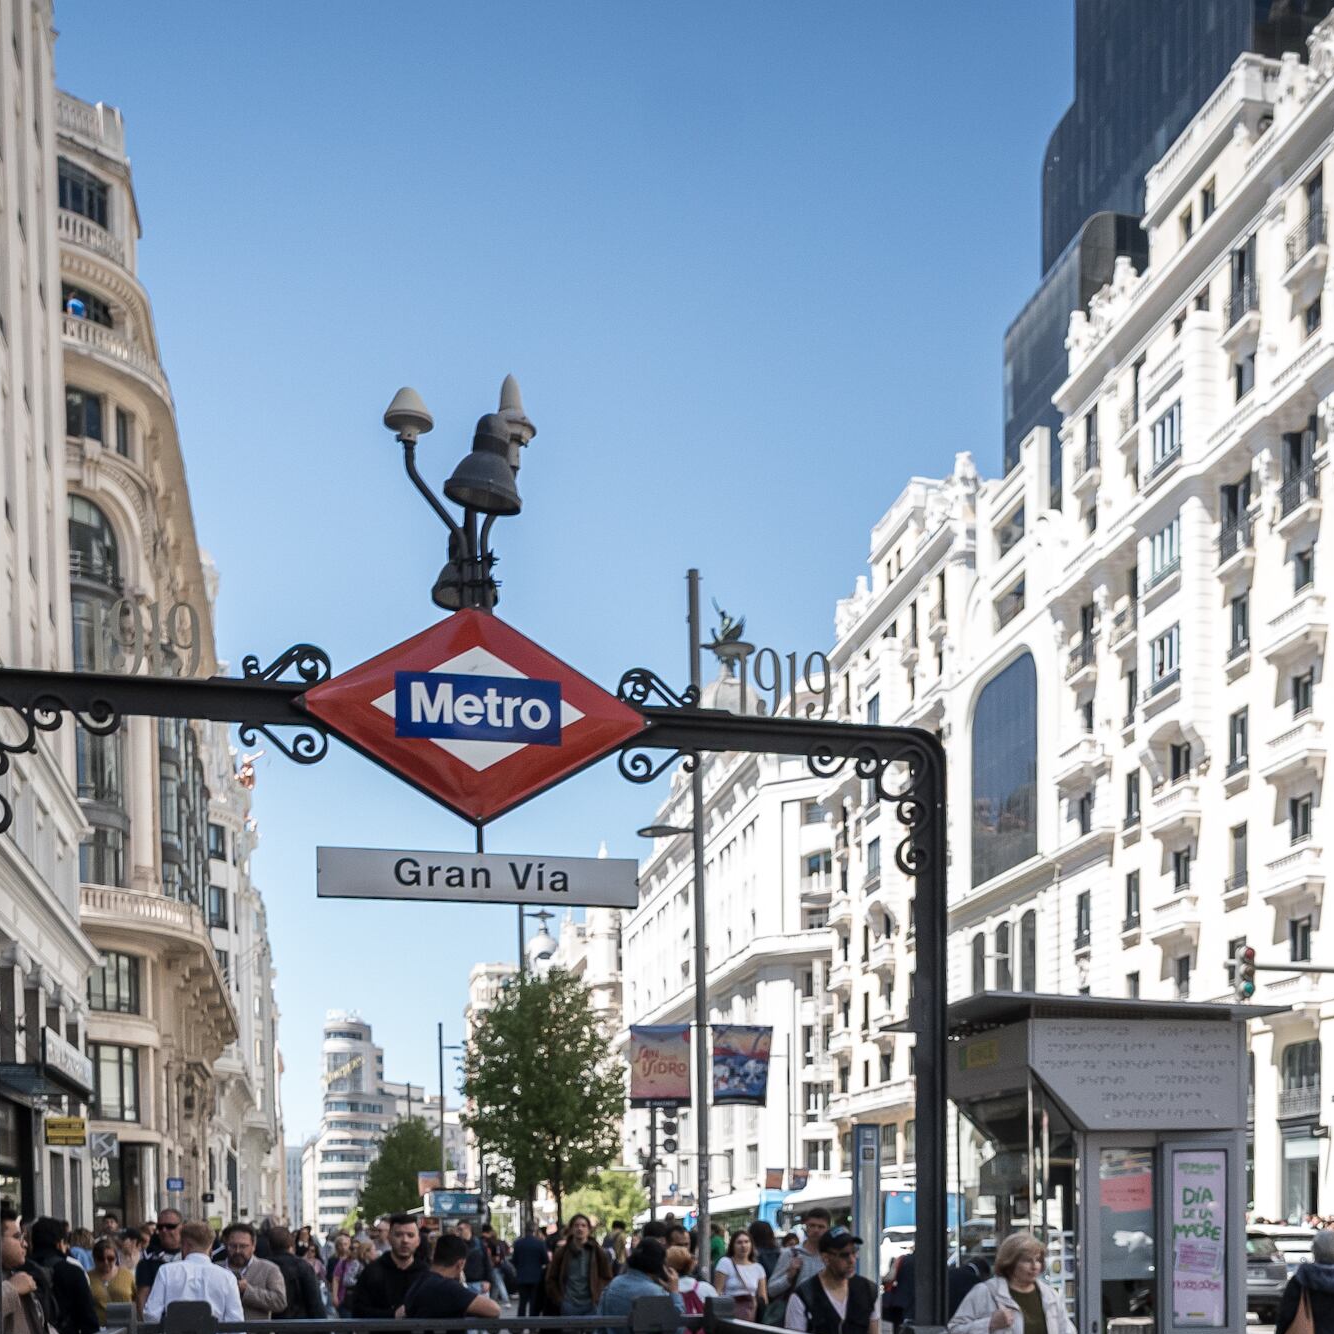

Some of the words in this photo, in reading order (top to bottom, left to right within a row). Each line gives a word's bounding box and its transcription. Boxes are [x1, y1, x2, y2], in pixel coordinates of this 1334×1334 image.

[737, 647, 831, 720] 1919
[410, 681, 551, 731] Metro
[394, 857, 491, 889] Gran
[508, 861, 570, 893] Vía
[1182, 1186, 1213, 1206] DÍA
